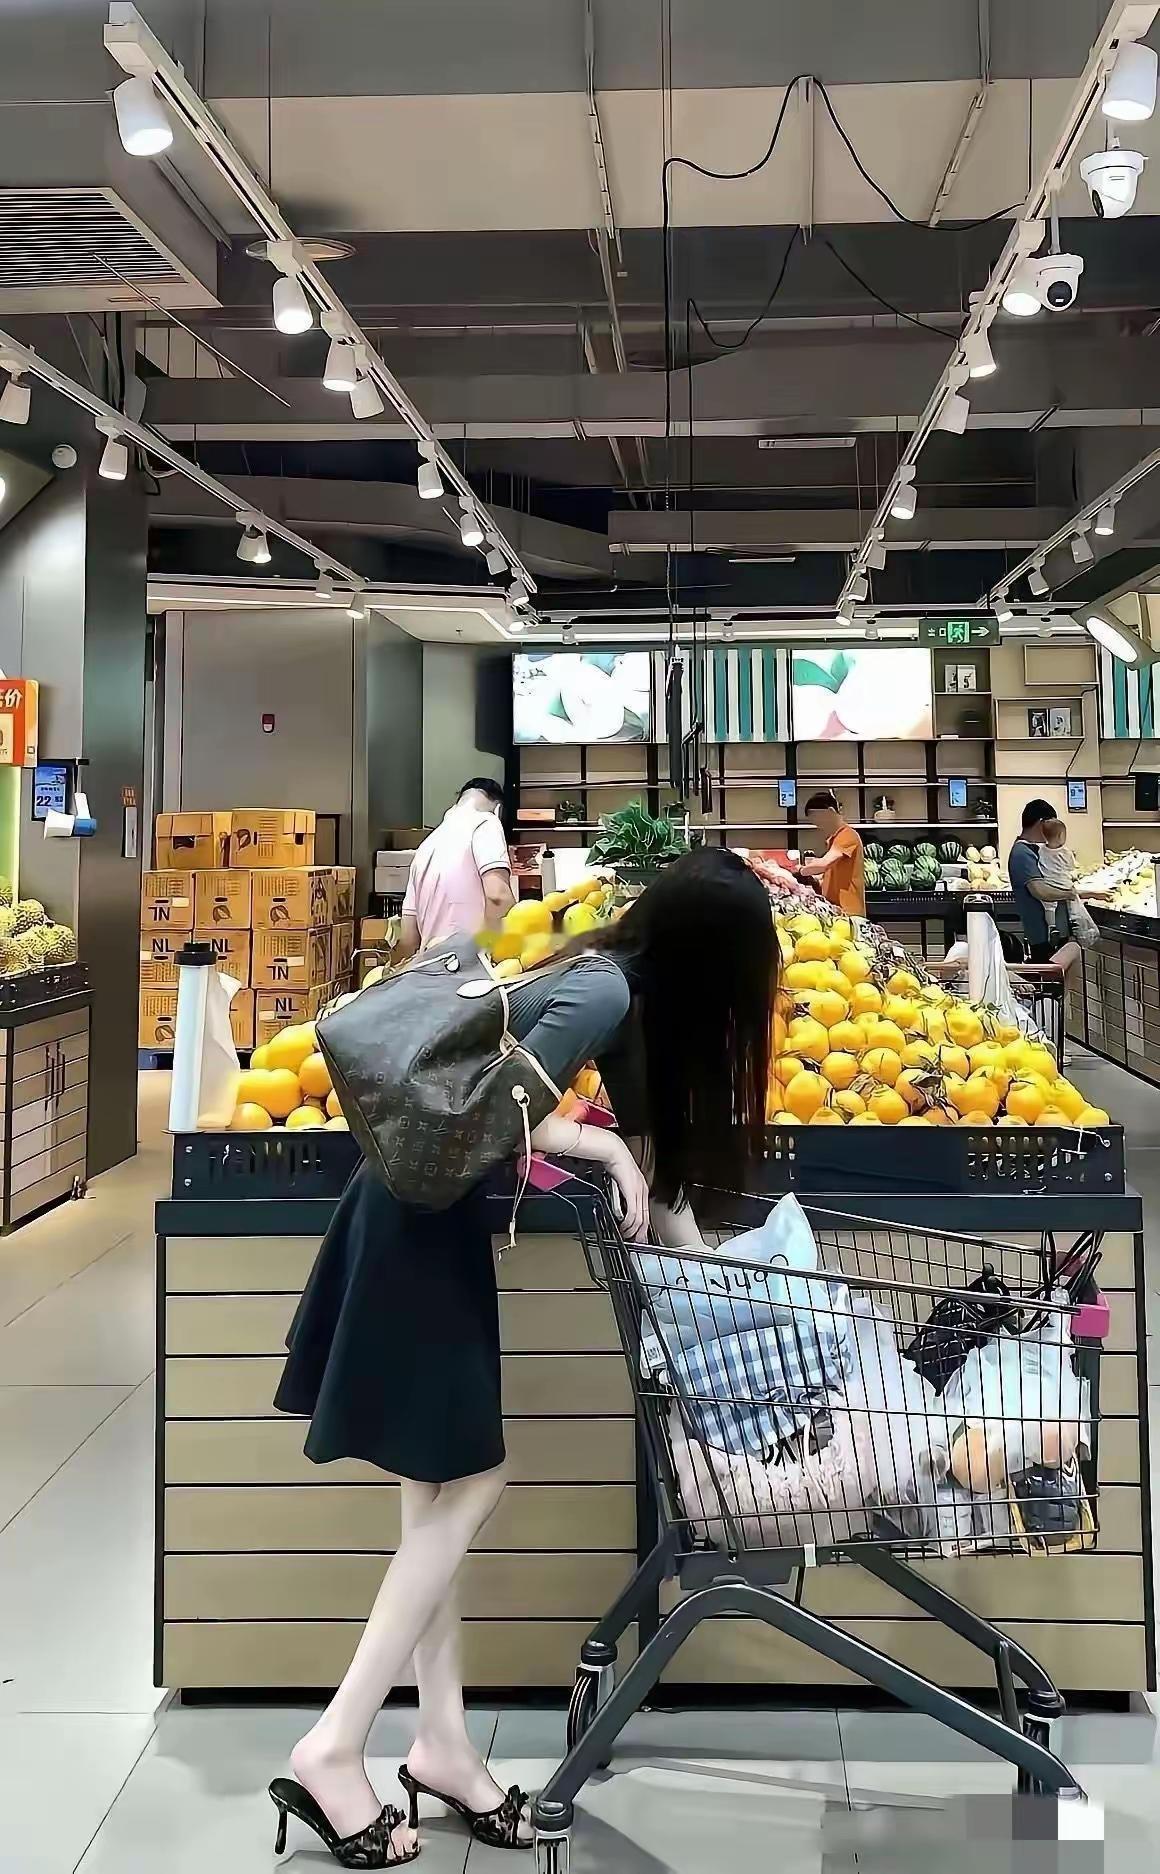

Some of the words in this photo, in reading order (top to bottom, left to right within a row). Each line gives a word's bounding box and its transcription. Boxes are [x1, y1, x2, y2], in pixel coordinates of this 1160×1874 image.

[36, 795, 52, 807] 22
[152, 938, 175, 953] NL
[211, 938, 234, 953] NL
[275, 997, 299, 1012] NL
